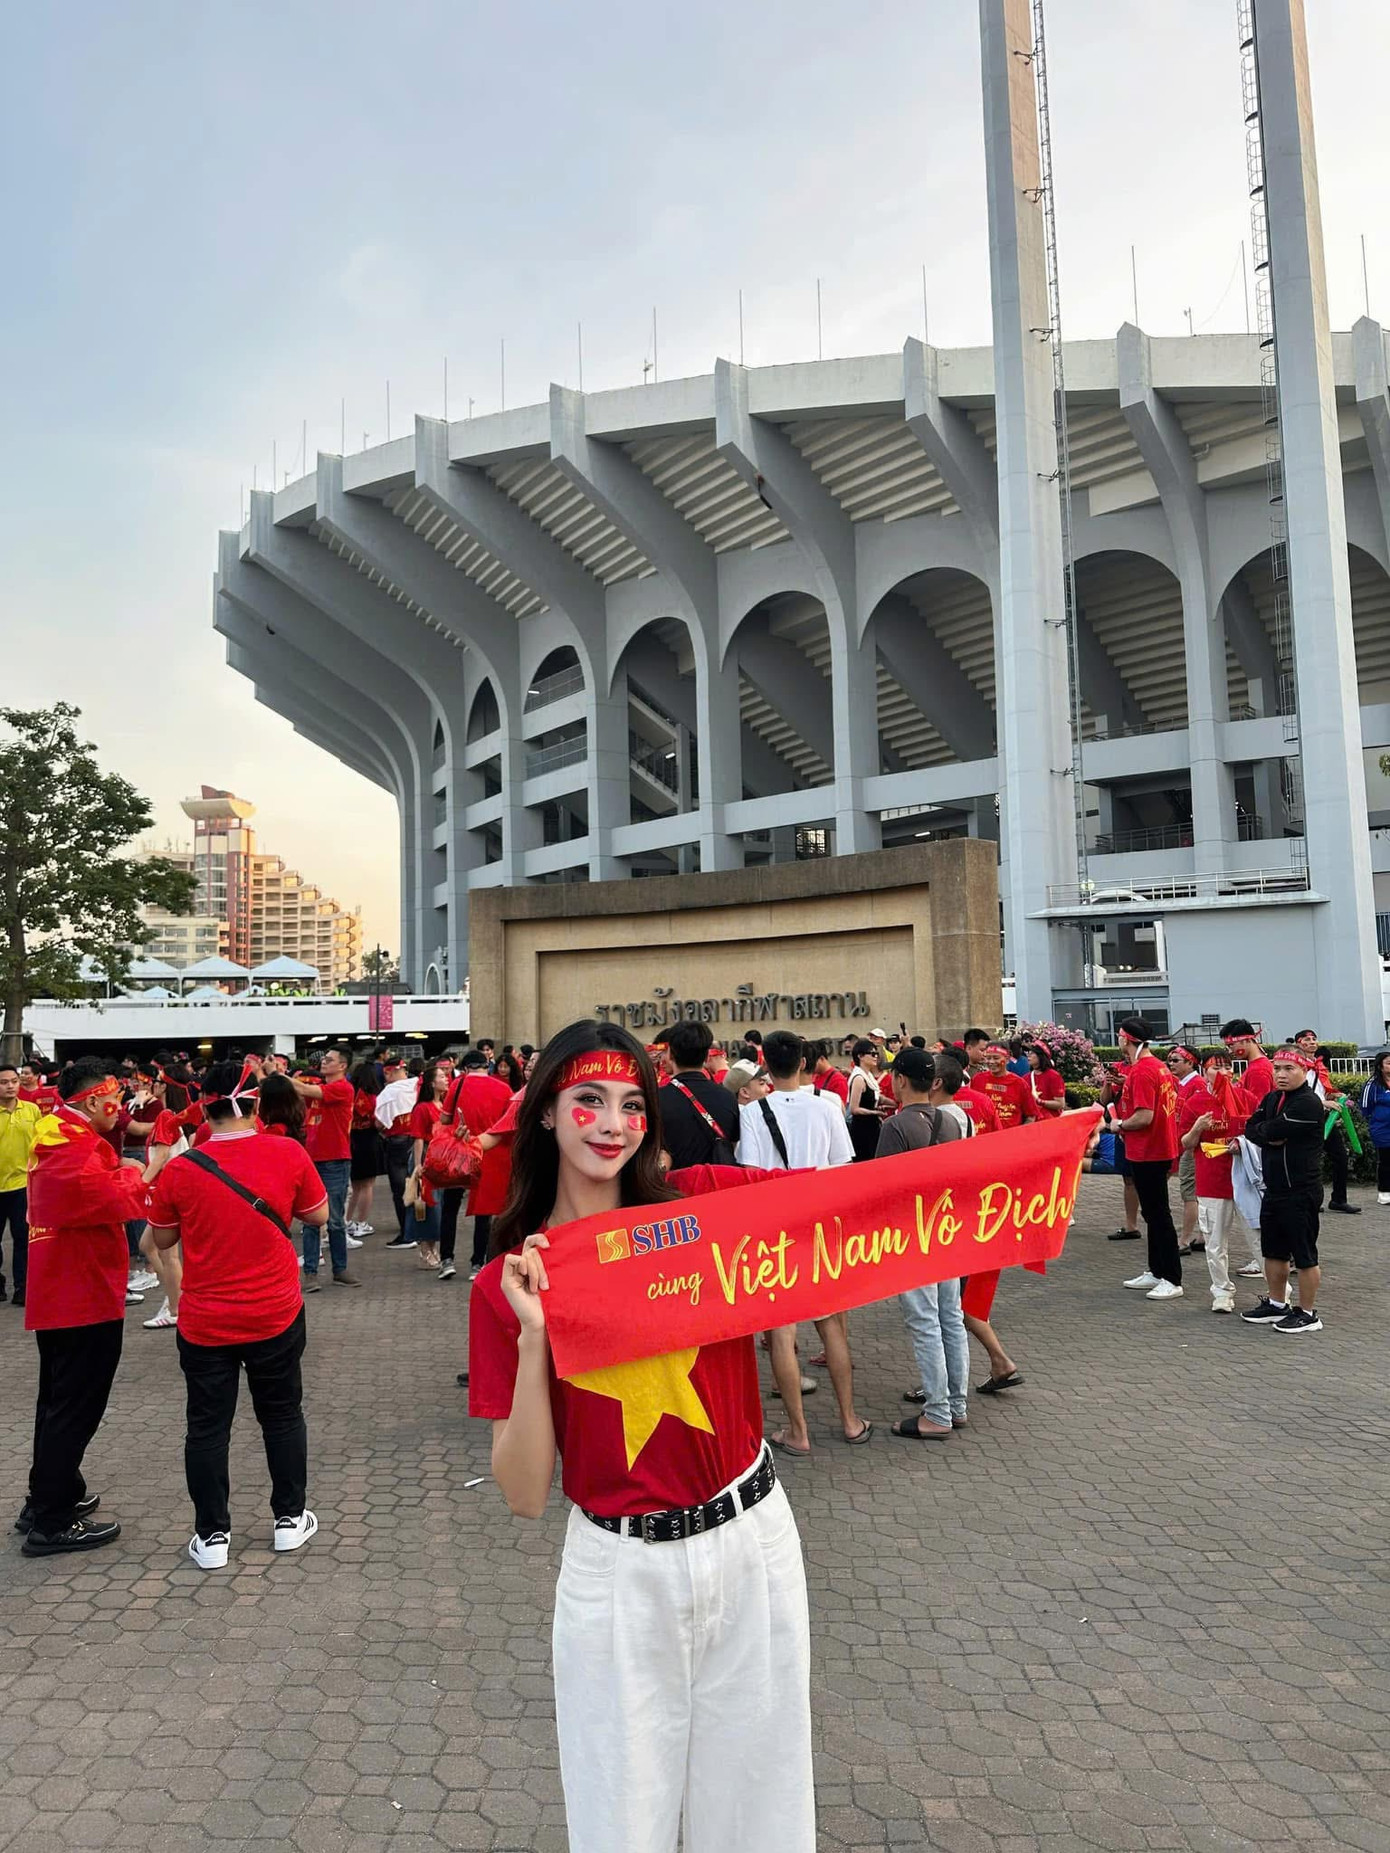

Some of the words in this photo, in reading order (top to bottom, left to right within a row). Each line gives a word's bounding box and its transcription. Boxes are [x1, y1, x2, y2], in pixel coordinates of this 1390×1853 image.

[594, 982, 870, 1028] ราชมังคลากีฬาสถาน
[569, 1058, 603, 1080] Nam
[606, 1054, 624, 1075] Vô
[632, 1214, 702, 1257] SHB
[647, 1272, 704, 1306] cùng
[711, 1230, 799, 1306] Việt
[811, 1216, 910, 1285] Nam
[915, 1188, 963, 1255] Vô
